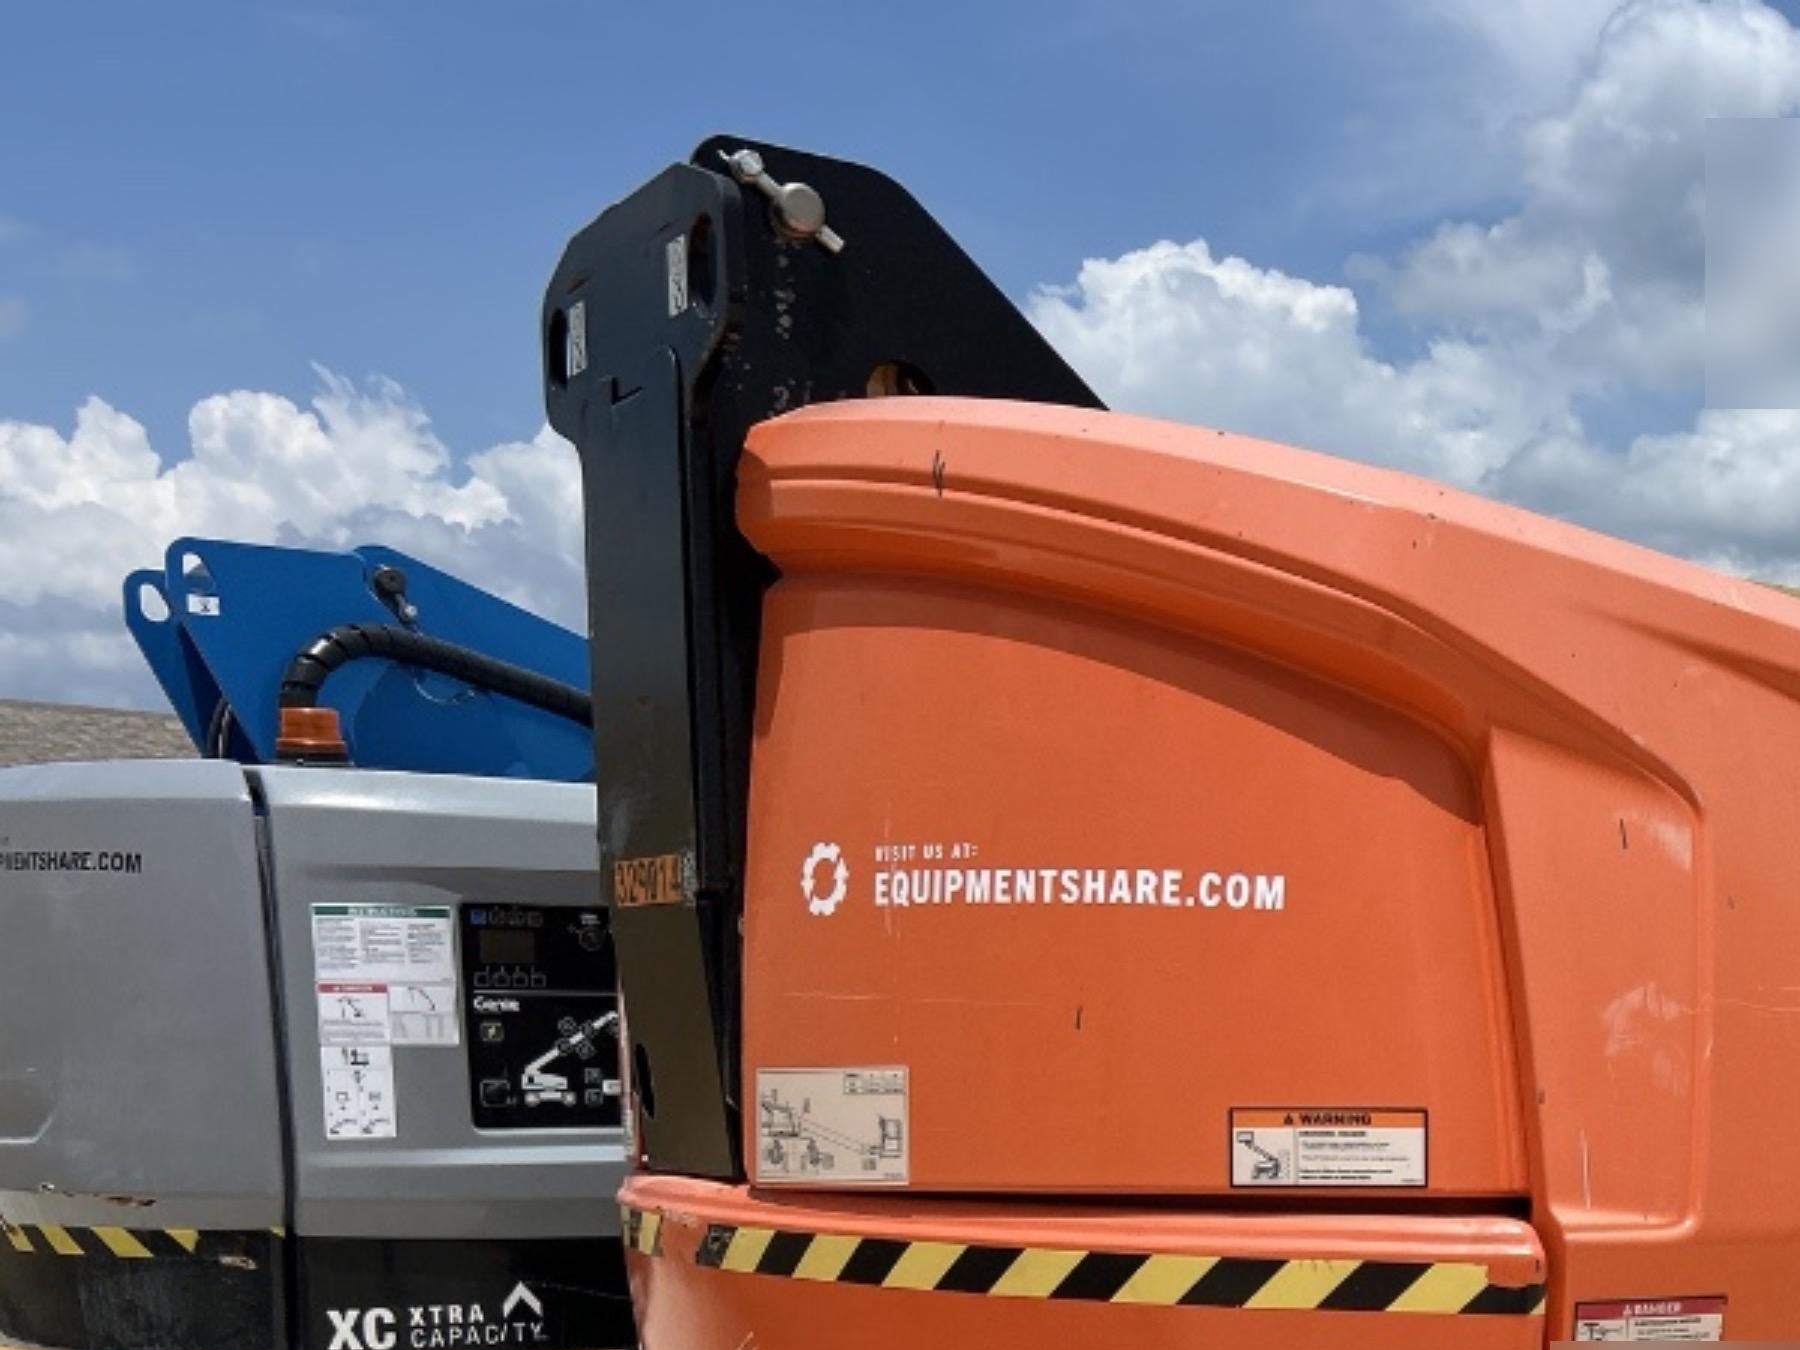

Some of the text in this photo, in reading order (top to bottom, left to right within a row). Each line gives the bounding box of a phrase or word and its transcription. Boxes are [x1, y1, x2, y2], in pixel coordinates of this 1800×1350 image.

[875, 842, 979, 862] VISIT US AT:
[875, 869, 1286, 911] EQUIPMENTSHARE.COM
[1299, 1113, 1372, 1126] WARNING
[408, 1304, 484, 1327] XTRA
[410, 1322, 544, 1349] CAPACITY
